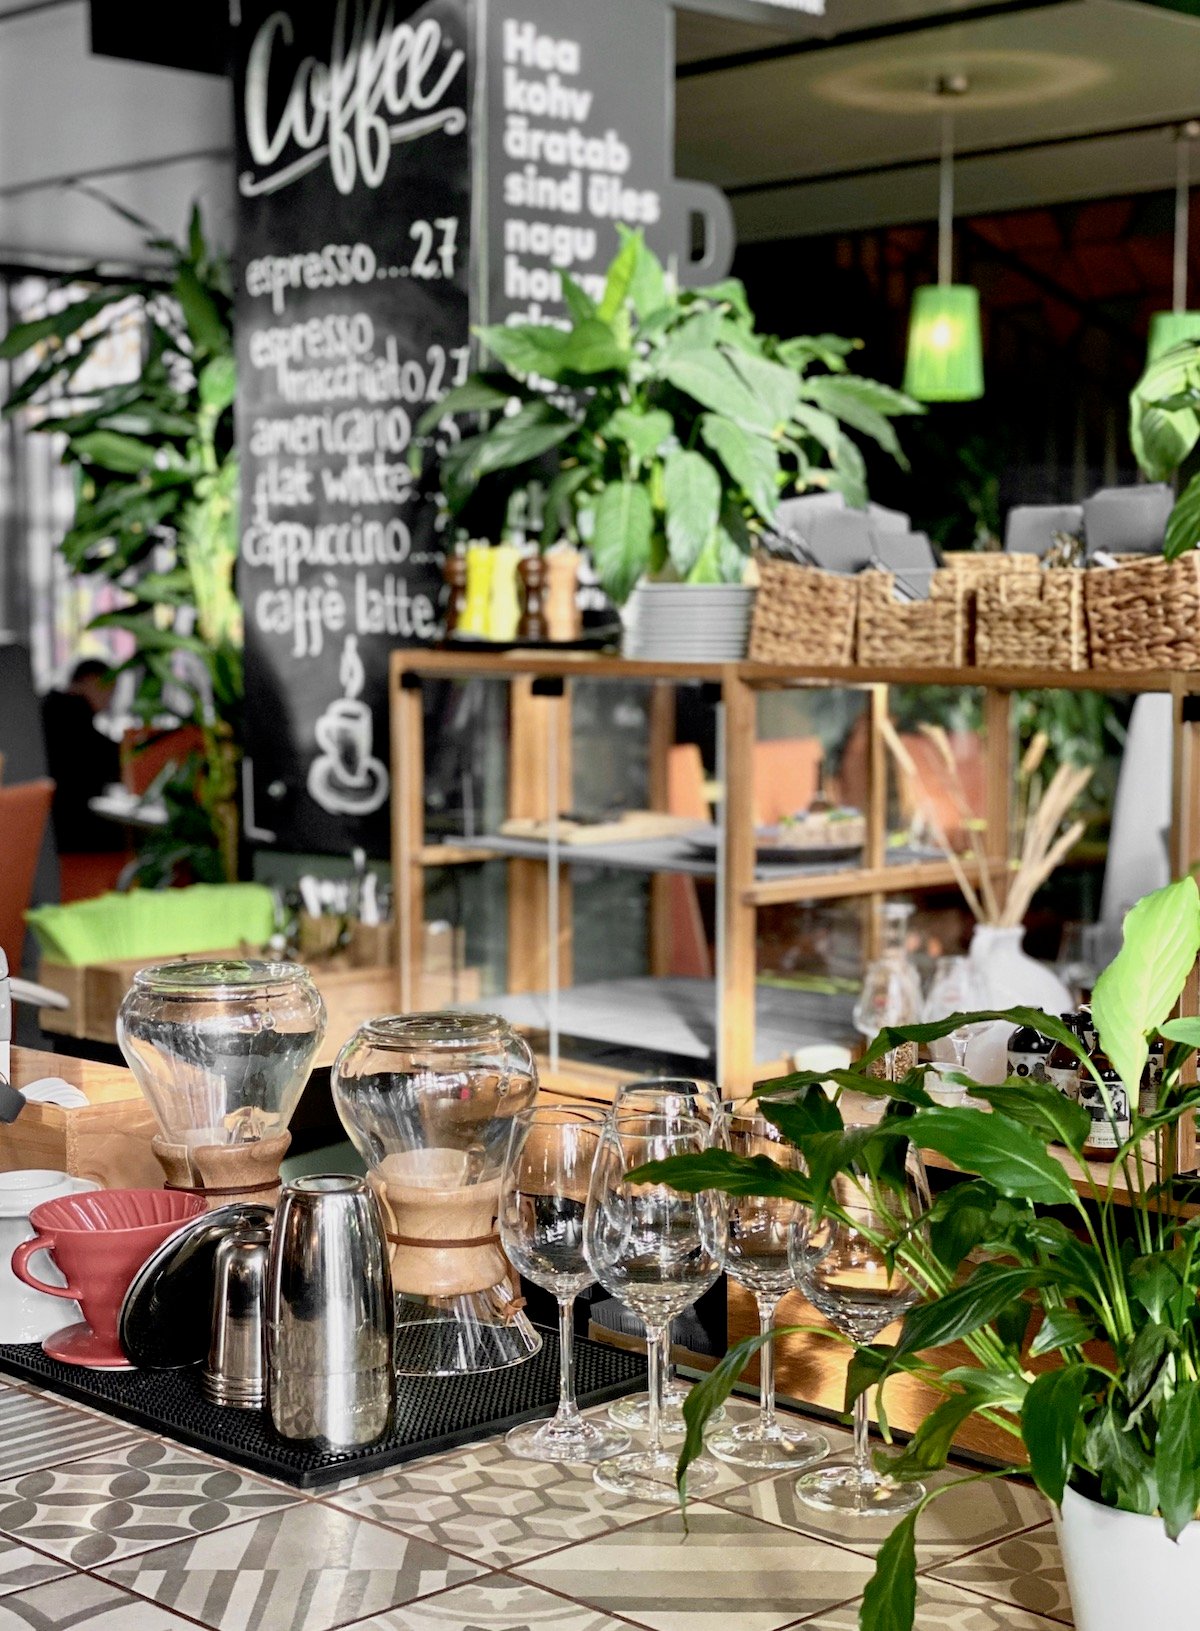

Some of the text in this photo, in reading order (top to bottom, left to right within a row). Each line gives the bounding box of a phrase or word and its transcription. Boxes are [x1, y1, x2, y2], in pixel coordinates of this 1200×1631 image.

[503, 18, 580, 74] Hea
[245, 0, 464, 194] Coffee
[503, 66, 594, 122] kohv
[503, 114, 631, 174] äratab
[504, 163, 661, 224] sind üles
[504, 218, 597, 267] nagu
